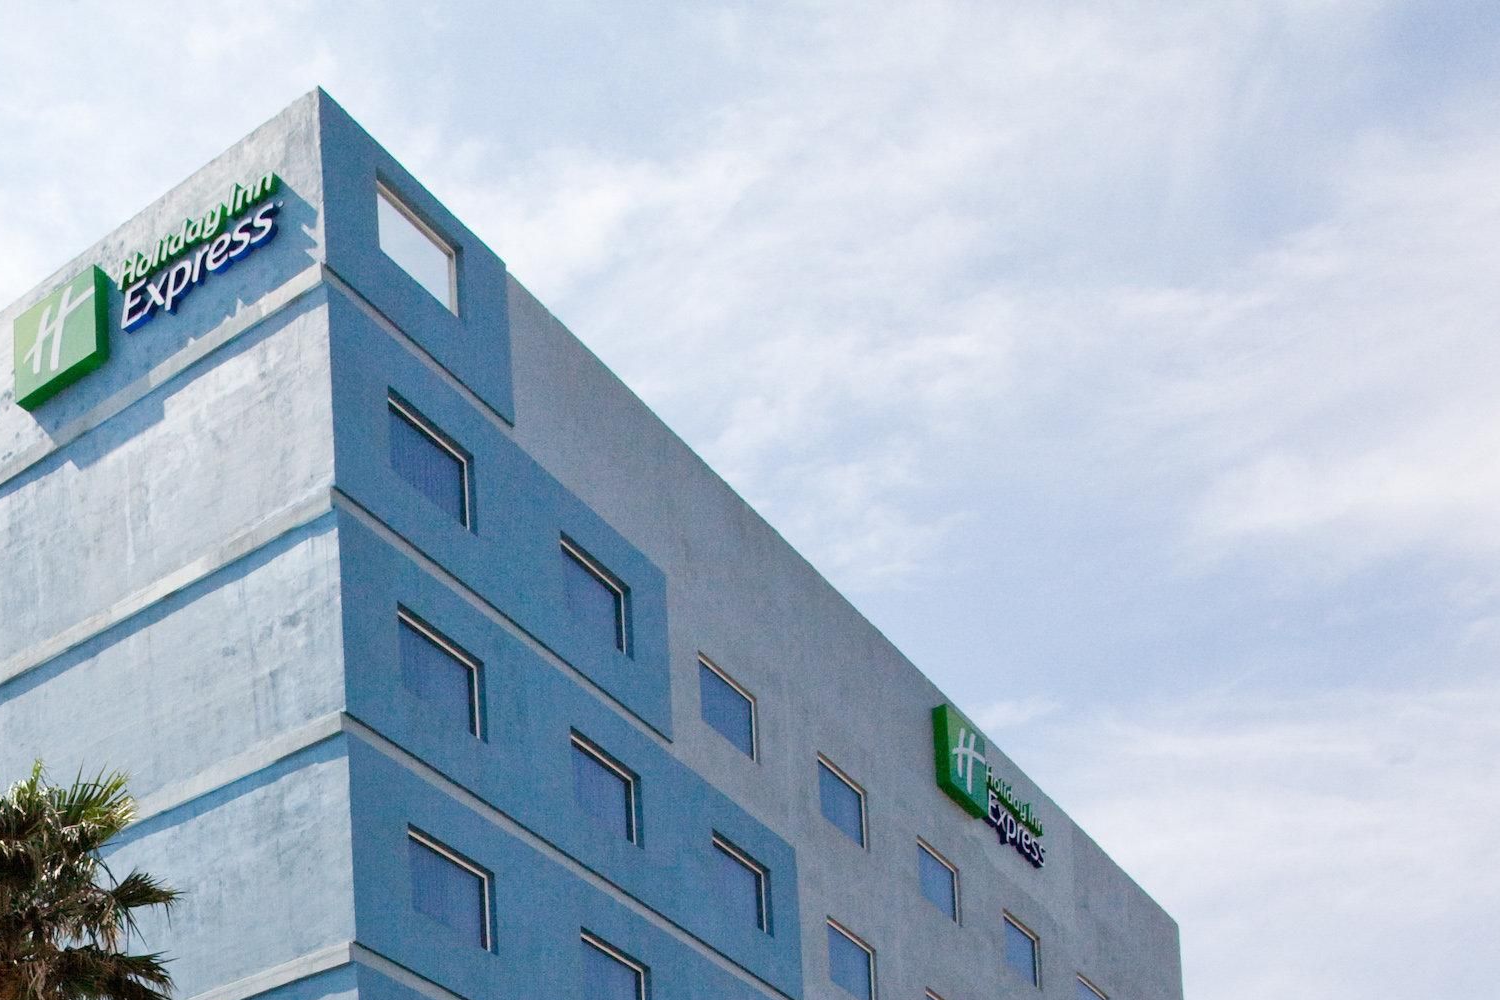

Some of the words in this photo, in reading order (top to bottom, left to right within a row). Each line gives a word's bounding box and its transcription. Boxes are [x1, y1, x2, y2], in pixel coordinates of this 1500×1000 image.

[116, 201, 224, 291] Holiday
[227, 171, 275, 217] Inn
[121, 201, 275, 330] Express
[986, 764, 1027, 822] Holiday
[1028, 802, 1044, 834] Inn
[988, 788, 1046, 867] Express
